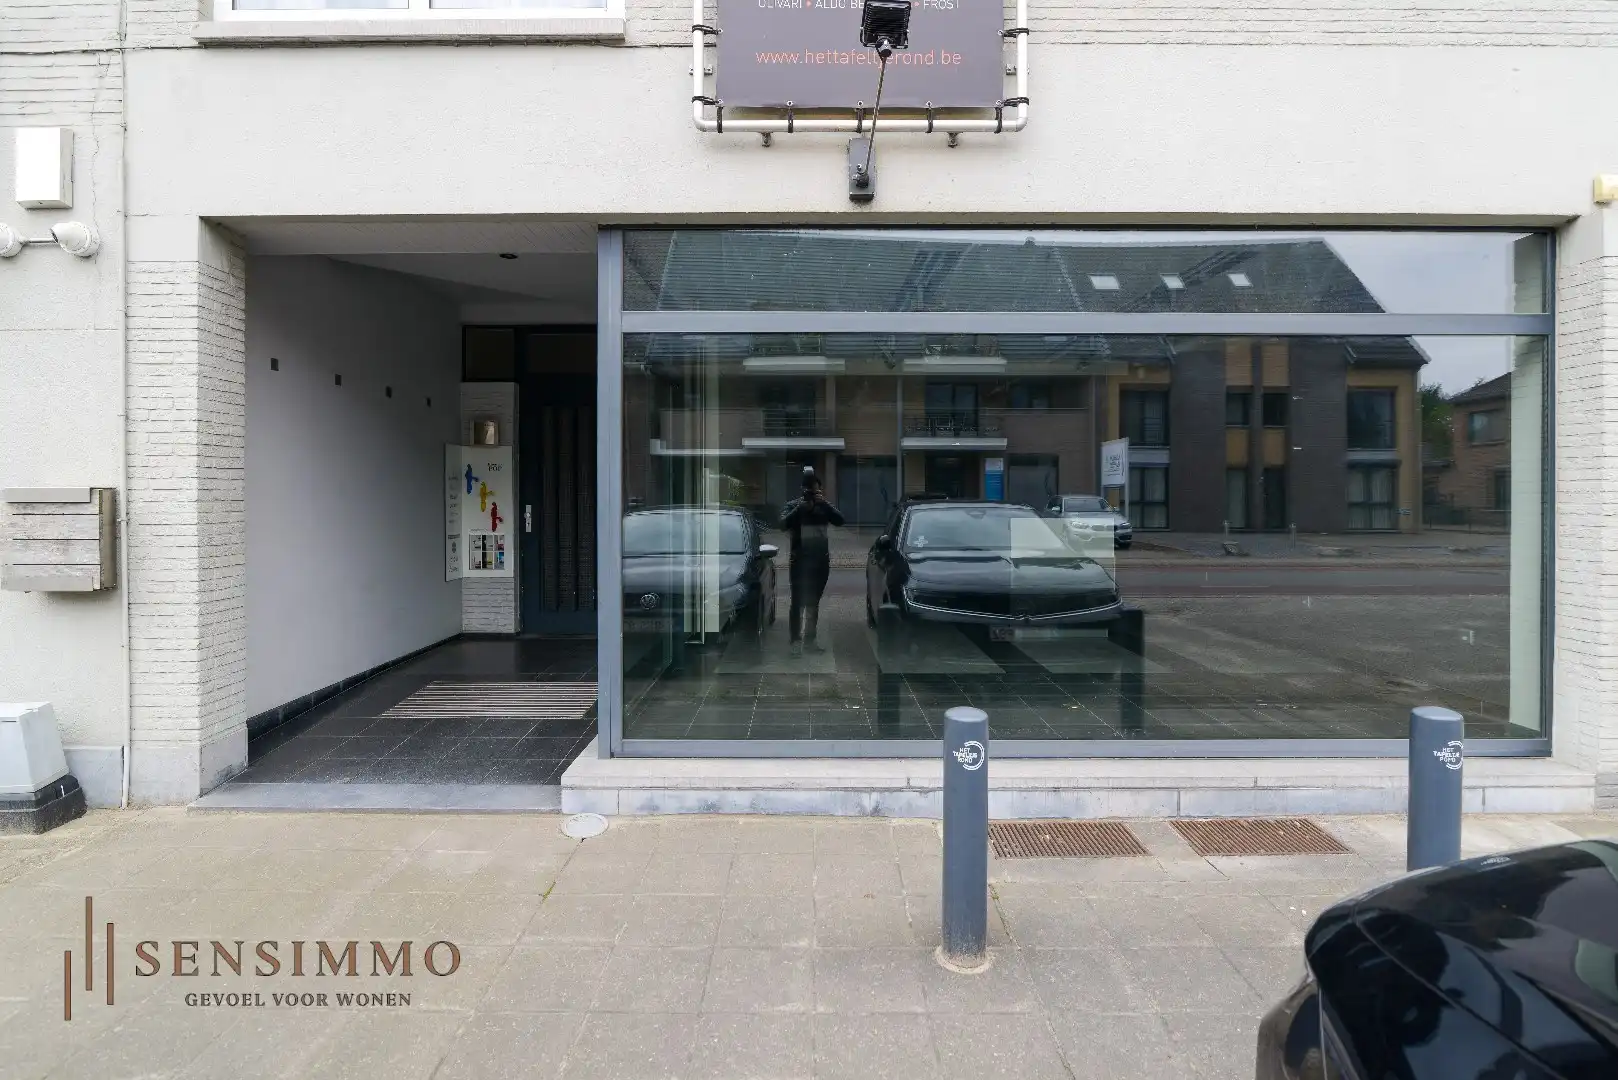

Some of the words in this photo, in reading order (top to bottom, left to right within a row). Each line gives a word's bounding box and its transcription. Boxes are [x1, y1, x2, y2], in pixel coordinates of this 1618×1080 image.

[758, 0, 802, 9] OLIVARI
[814, 0, 846, 9] ALDO
[923, 0, 959, 9] FROST
